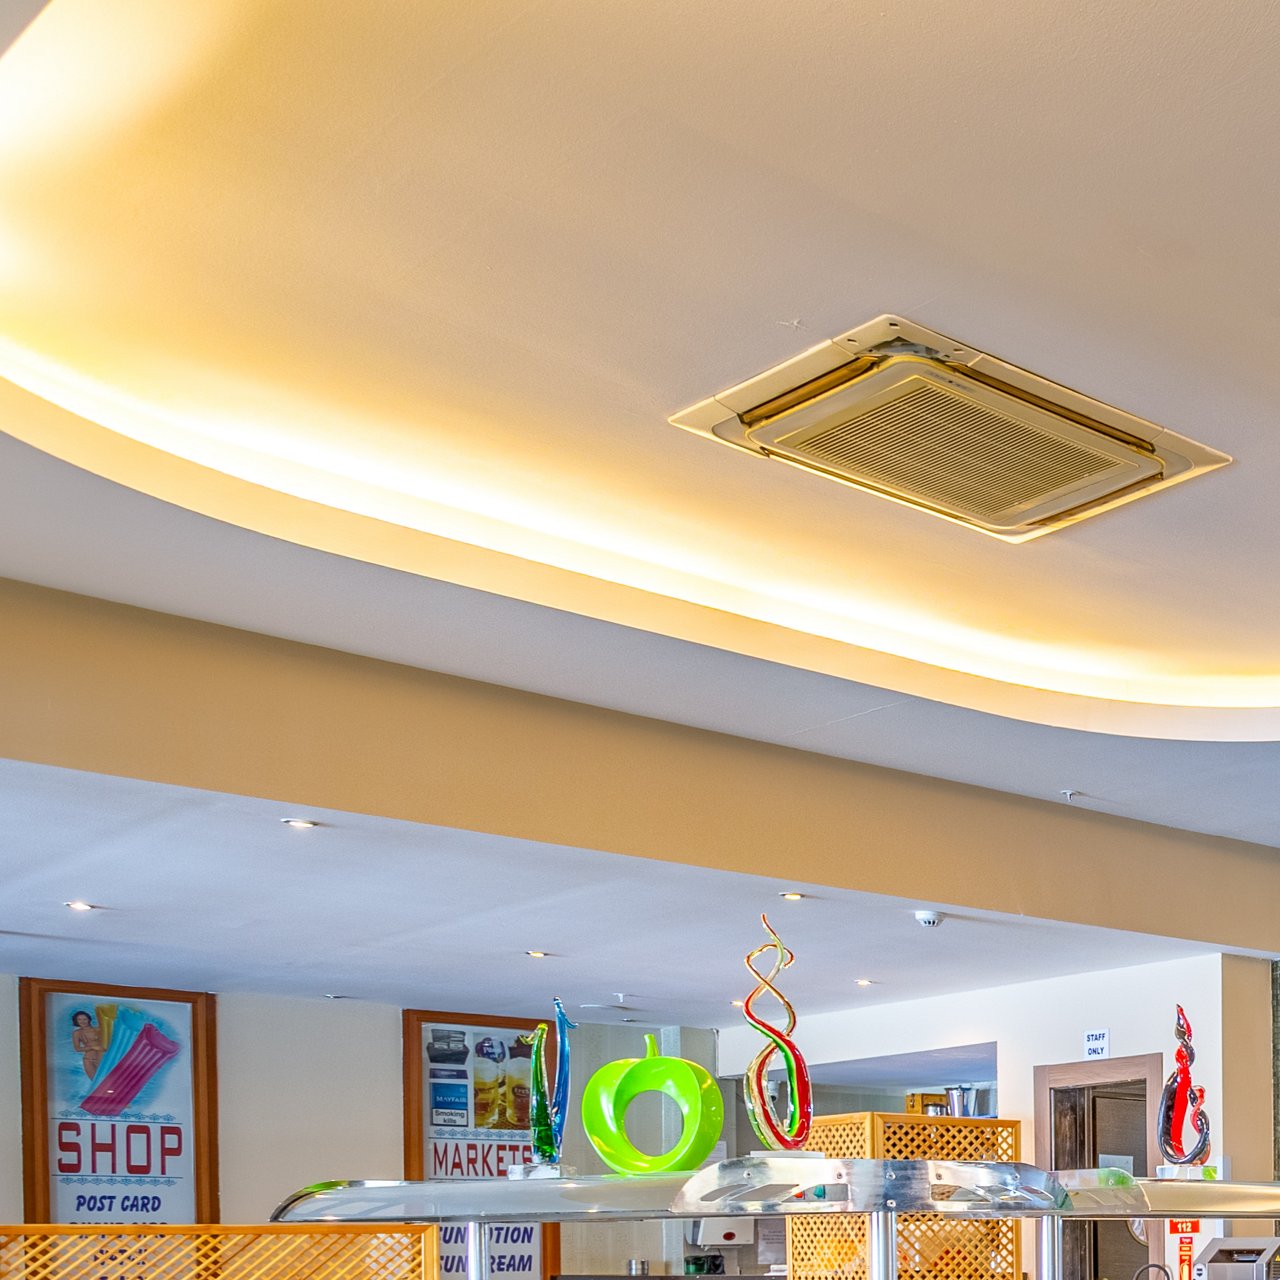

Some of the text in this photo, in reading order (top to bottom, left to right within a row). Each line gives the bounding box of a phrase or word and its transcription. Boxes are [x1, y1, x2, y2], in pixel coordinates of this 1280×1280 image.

[1086, 1033, 1105, 1042] STAFF
[1087, 1047, 1104, 1055] ONLY
[434, 1109, 465, 1118] Smoking
[57, 1122, 183, 1175] SHOP
[76, 1195, 162, 1213] POST CARD
[1177, 1222, 1192, 1233] 112
[440, 1226, 534, 1244] UN TION
